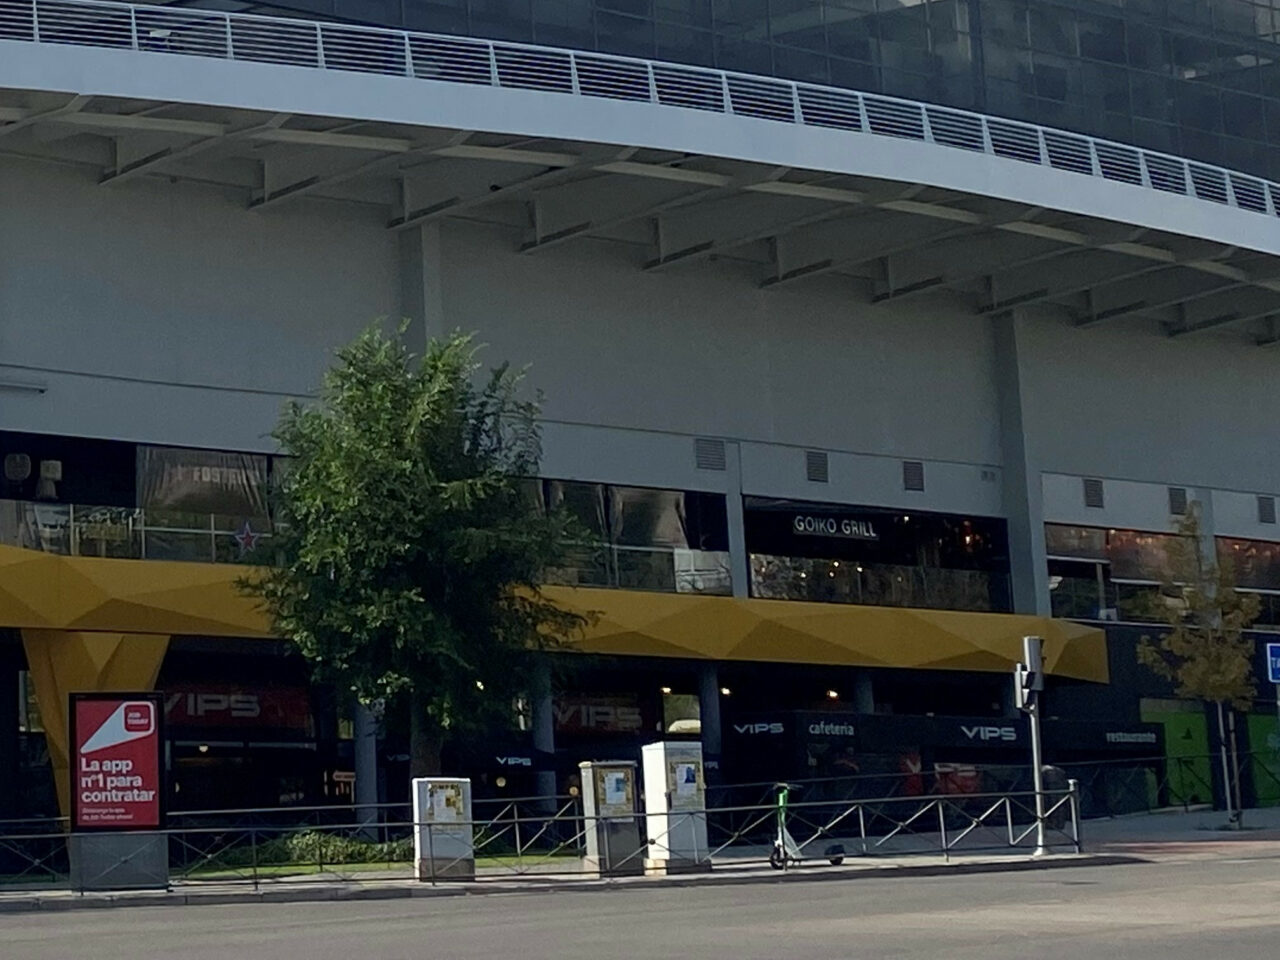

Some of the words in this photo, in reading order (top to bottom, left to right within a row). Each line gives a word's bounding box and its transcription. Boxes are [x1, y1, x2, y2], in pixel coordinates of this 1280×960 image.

[794, 515, 837, 534] GOIKO
[841, 519, 877, 537] GRILL
[733, 722, 785, 735] VIPS
[960, 725, 1017, 741] VIPS
[81, 757, 100, 772] La
[102, 759, 133, 774] app
[107, 775, 142, 790] para
[81, 789, 156, 803] contratar
